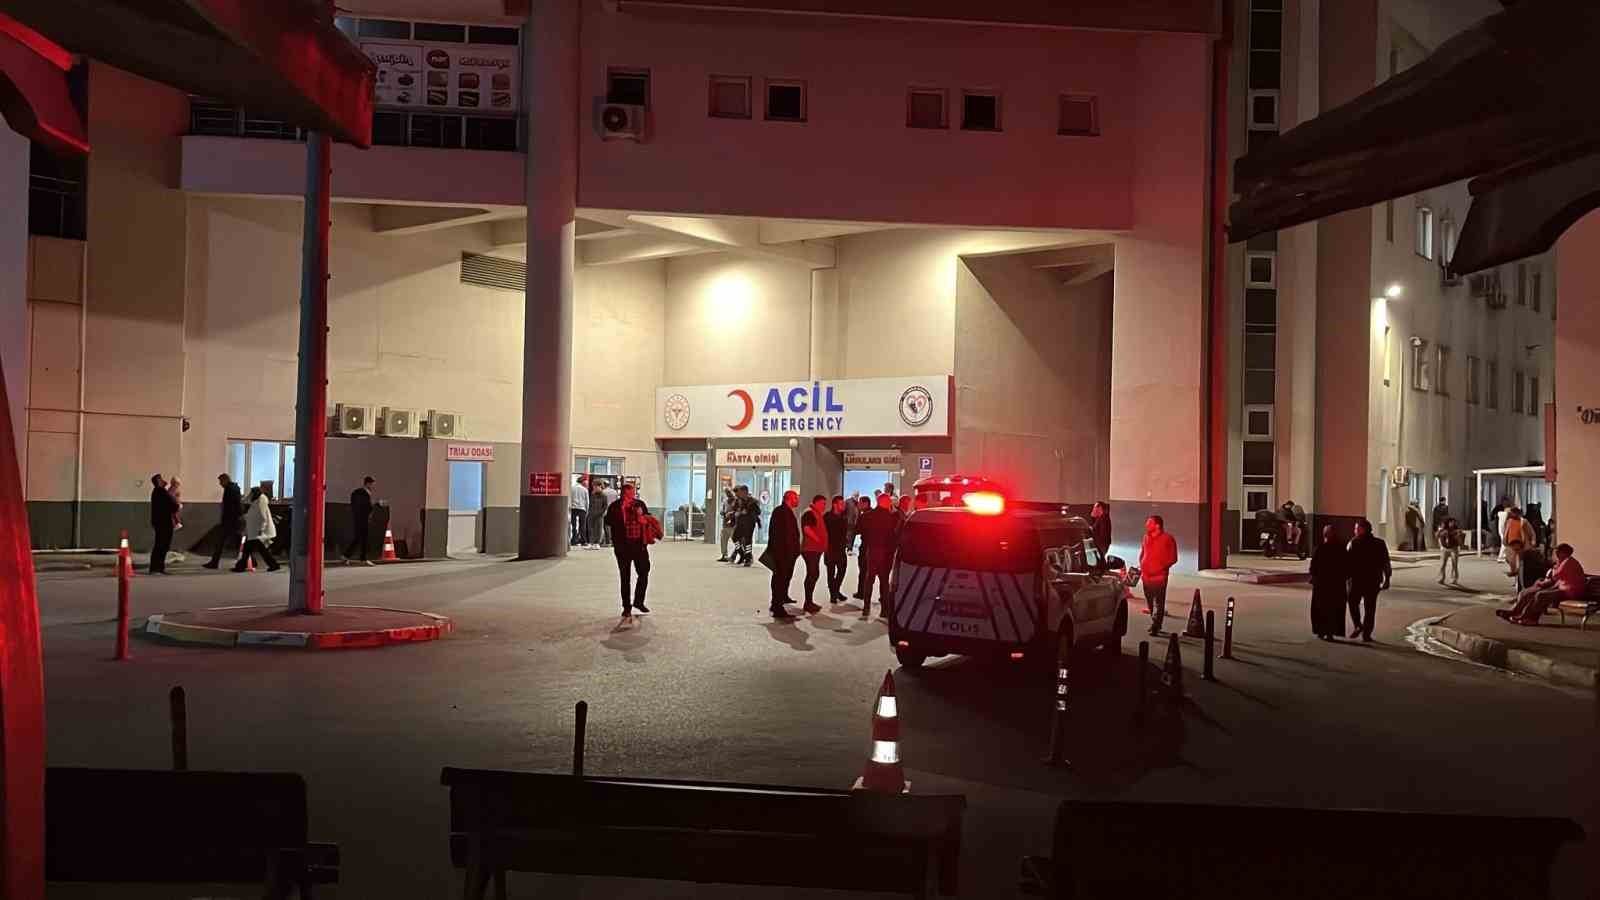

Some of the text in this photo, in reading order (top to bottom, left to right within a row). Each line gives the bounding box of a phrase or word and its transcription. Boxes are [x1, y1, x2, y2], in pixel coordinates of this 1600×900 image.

[762, 381, 844, 413] ACİL
[762, 417, 843, 431] EMERGENCY
[922, 459, 930, 469] P
